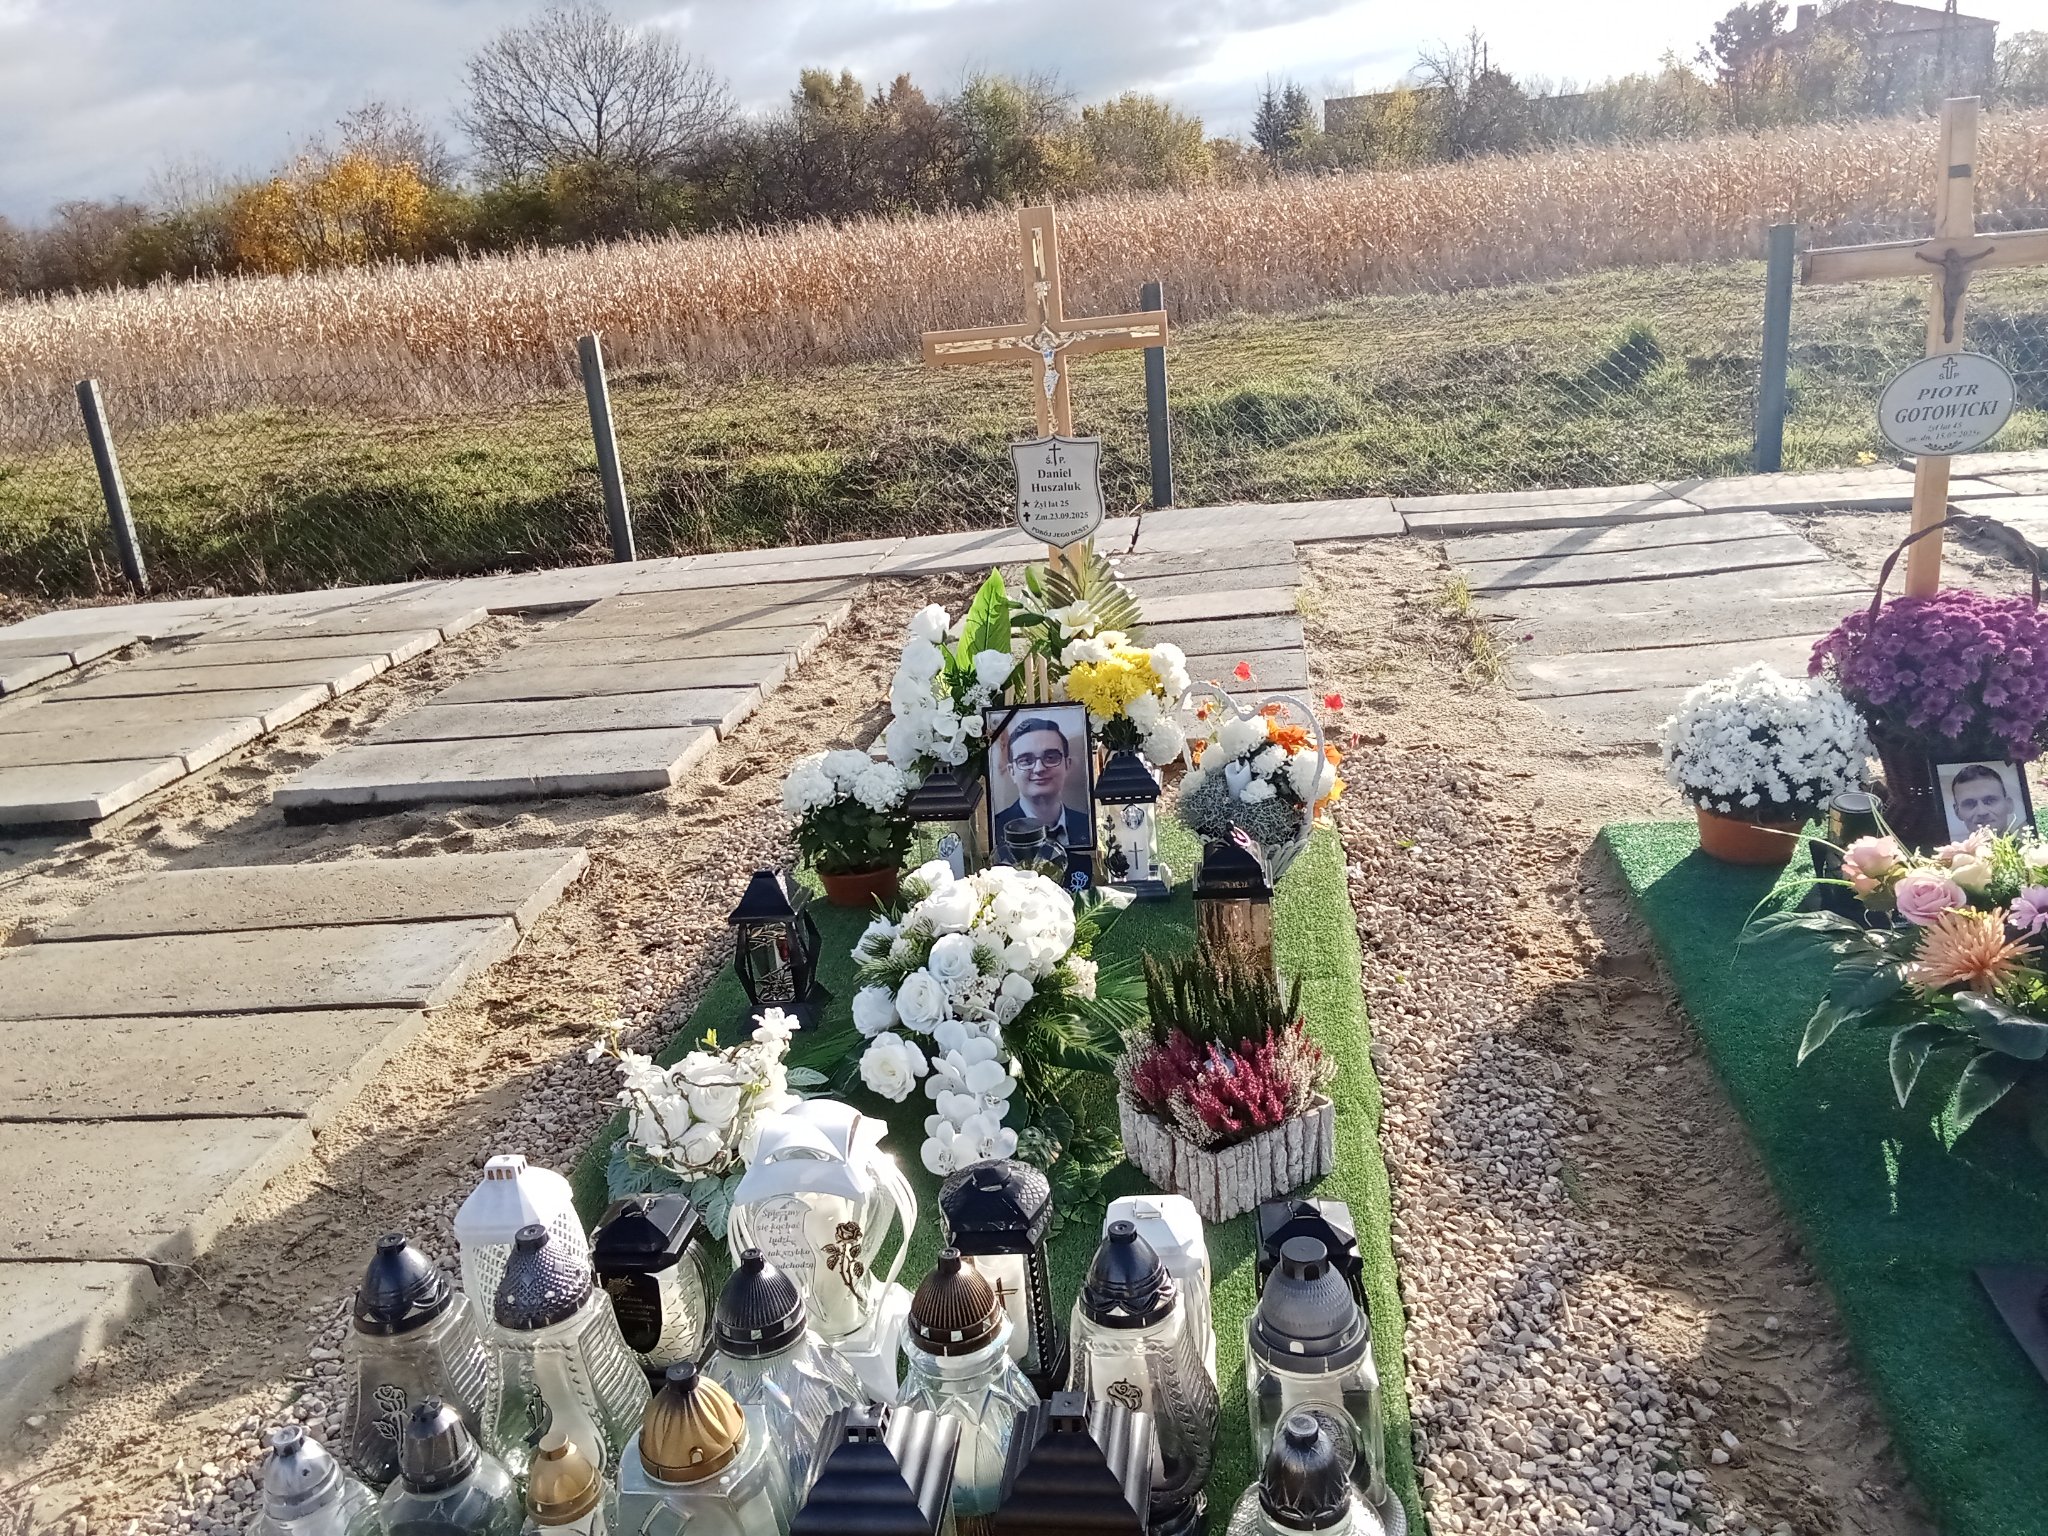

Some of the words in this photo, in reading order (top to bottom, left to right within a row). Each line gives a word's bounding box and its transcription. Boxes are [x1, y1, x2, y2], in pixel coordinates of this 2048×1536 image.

[1917, 384, 1979, 401] PIOTR
[1895, 400, 1999, 423] GOTOWICKI
[1038, 468, 1072, 479] Daniel
[1031, 482, 1081, 493] Huszaluk
[1048, 500, 1058, 508] lat
[1060, 499, 1070, 507] 25
